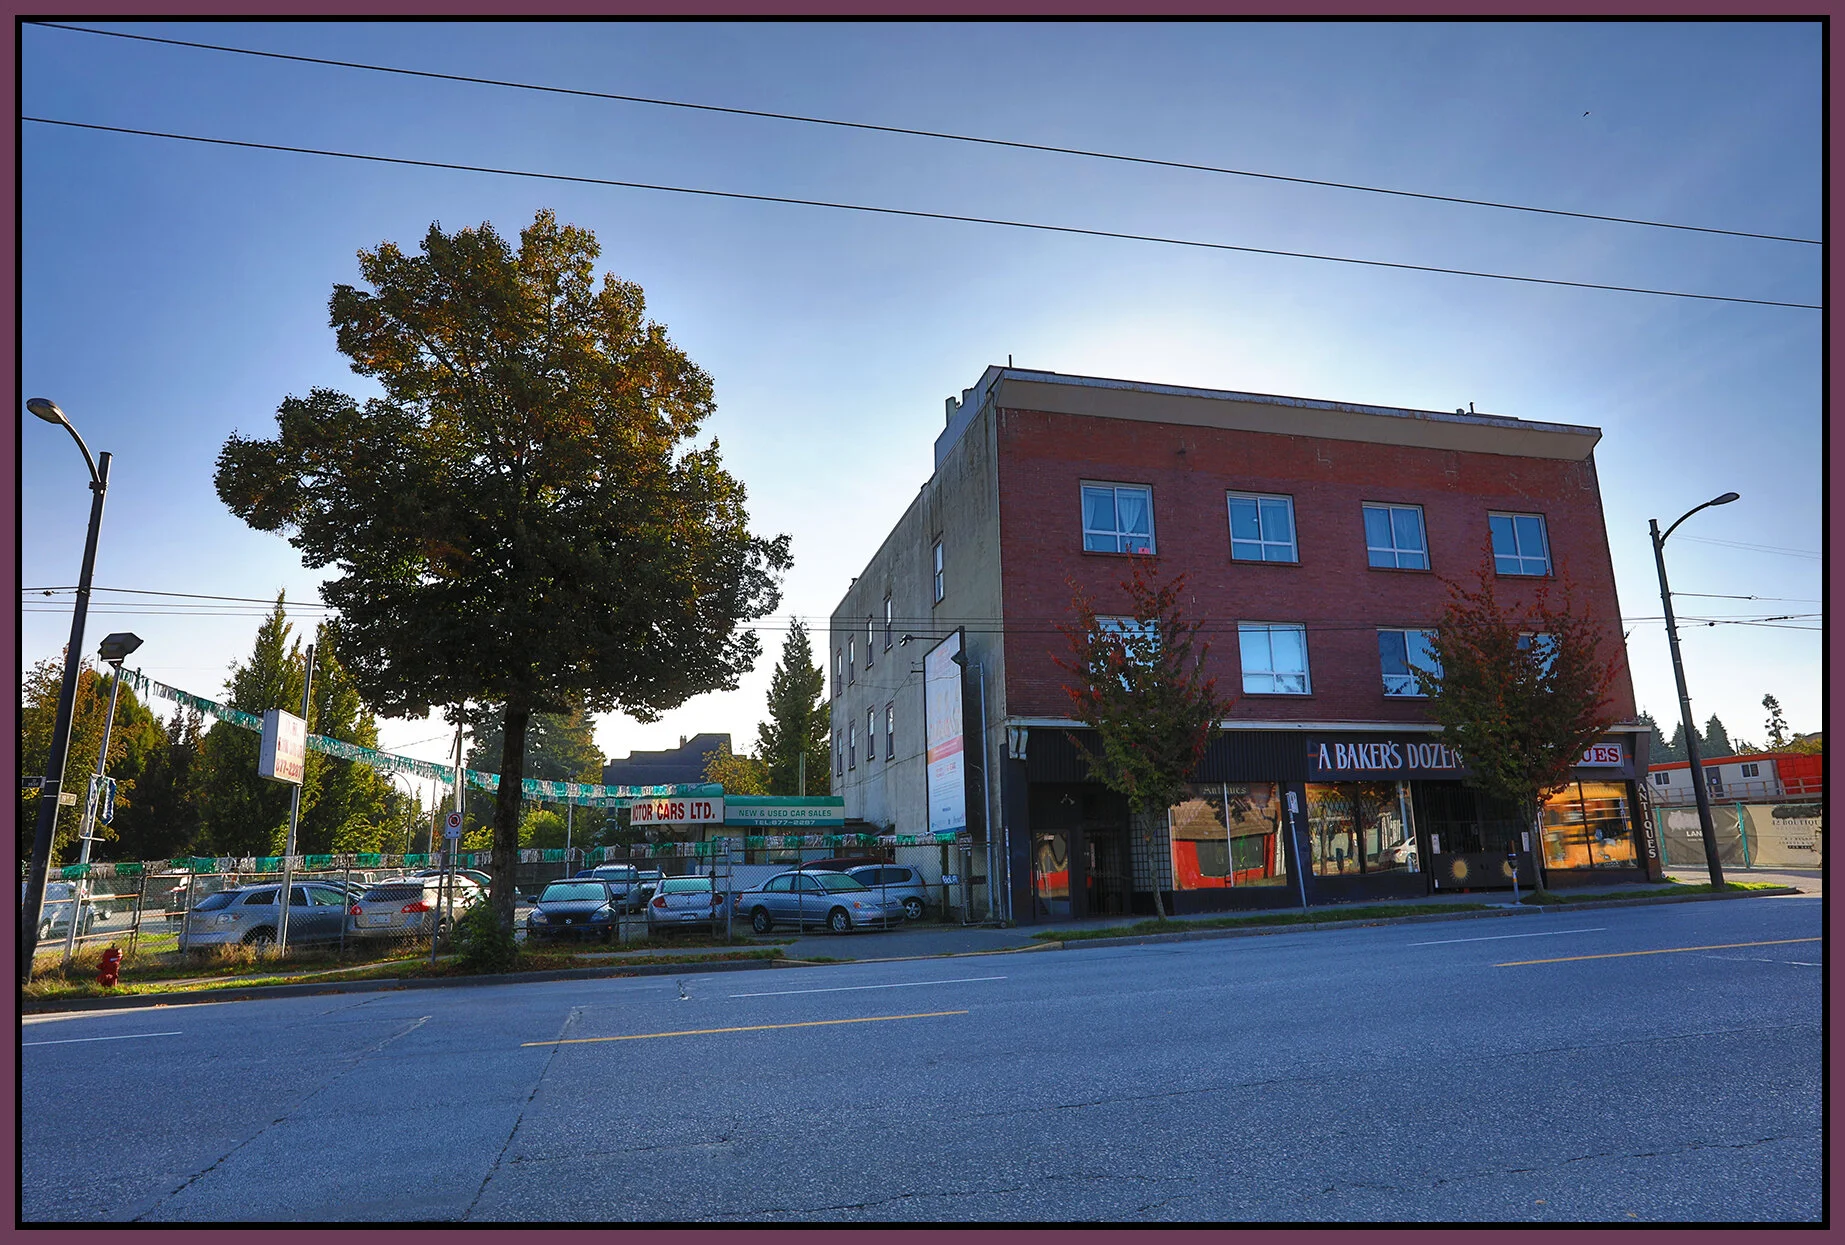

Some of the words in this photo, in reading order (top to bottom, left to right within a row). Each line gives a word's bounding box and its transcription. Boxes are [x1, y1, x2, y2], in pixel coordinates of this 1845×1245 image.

[1318, 743, 1332, 769] A
[1334, 741, 1403, 769] BAKER'S
[656, 802, 684, 821] CARS
[690, 802, 716, 820] LTD.
[738, 809, 757, 817] NEW
[759, 809, 765, 817] &
[767, 809, 788, 817] USED
[790, 809, 806, 817] CAR
[808, 809, 832, 817] SALES
[1638, 783, 1657, 859] ANTIQUES
